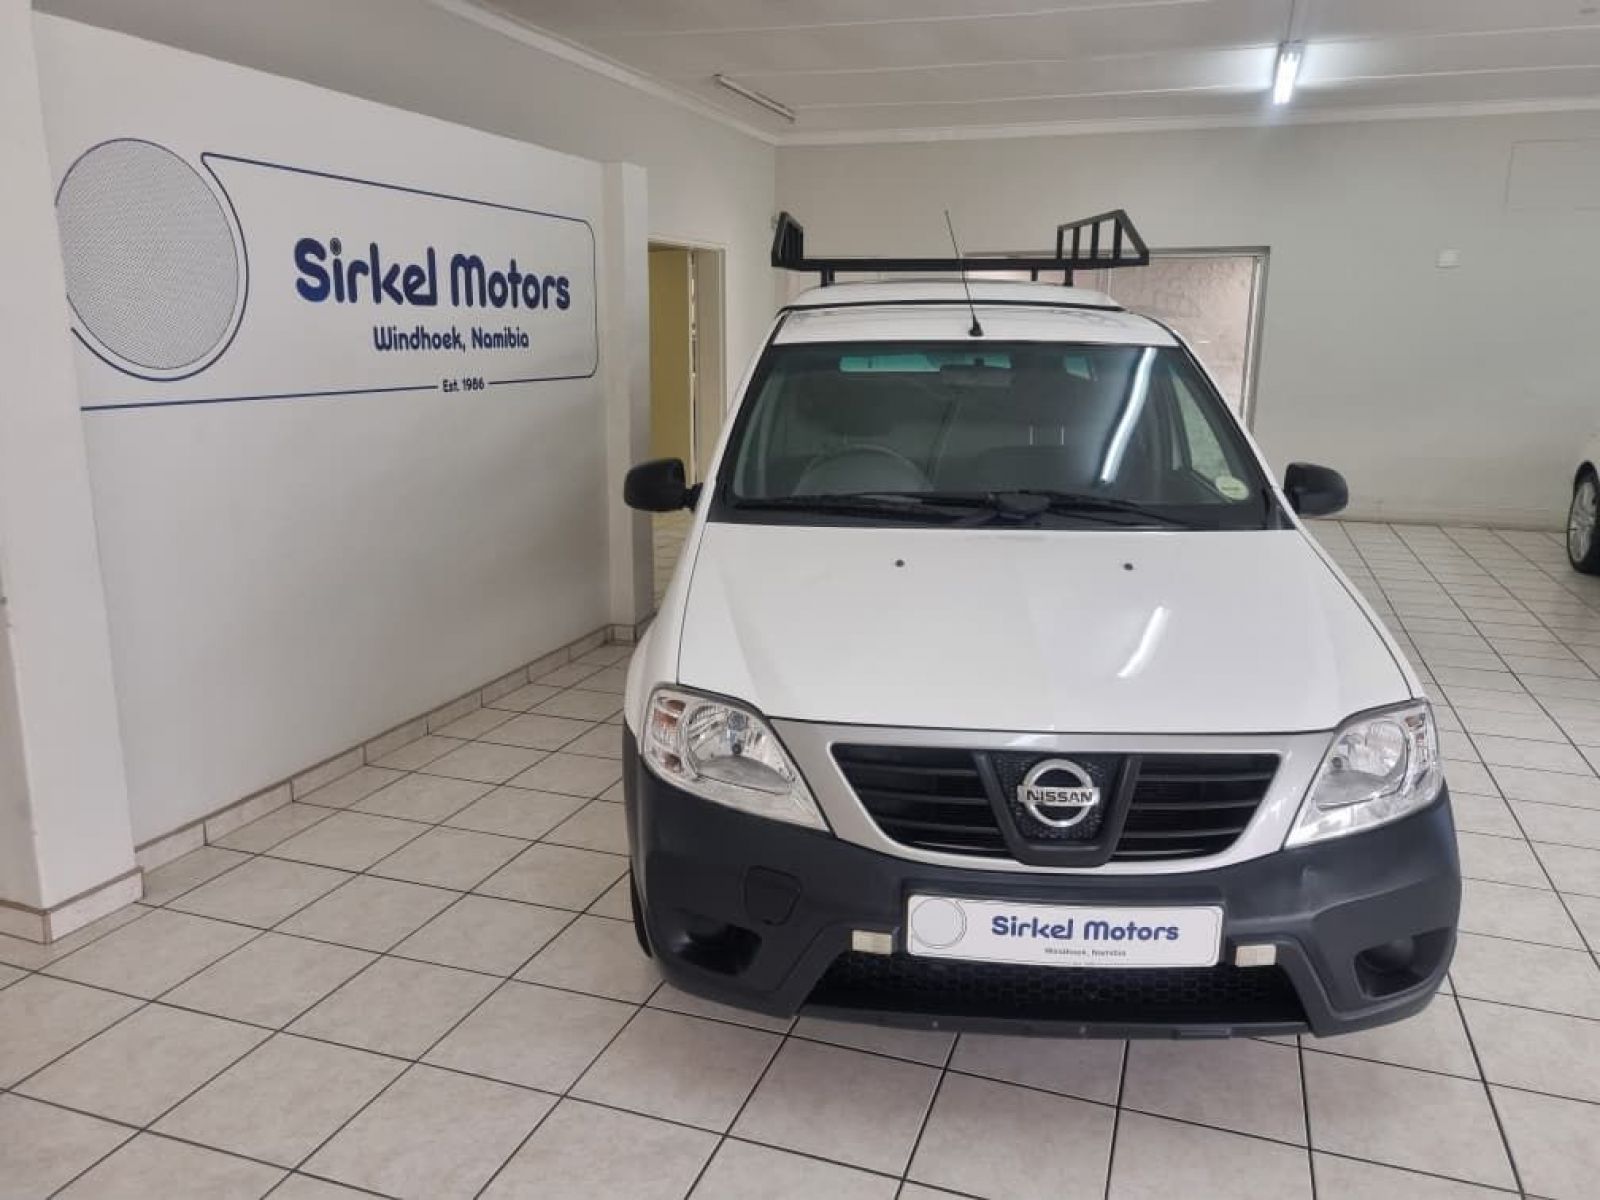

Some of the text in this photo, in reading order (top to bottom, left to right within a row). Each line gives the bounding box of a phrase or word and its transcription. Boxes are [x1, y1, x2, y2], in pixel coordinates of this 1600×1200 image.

[294, 237, 571, 310] Sirkel Motors
[373, 325, 530, 353] Windhoek, Namibia
[442, 376, 485, 393] Est. 1986
[1026, 789, 1093, 802] NISSAN
[991, 915, 1179, 941] Sirkel Motors
